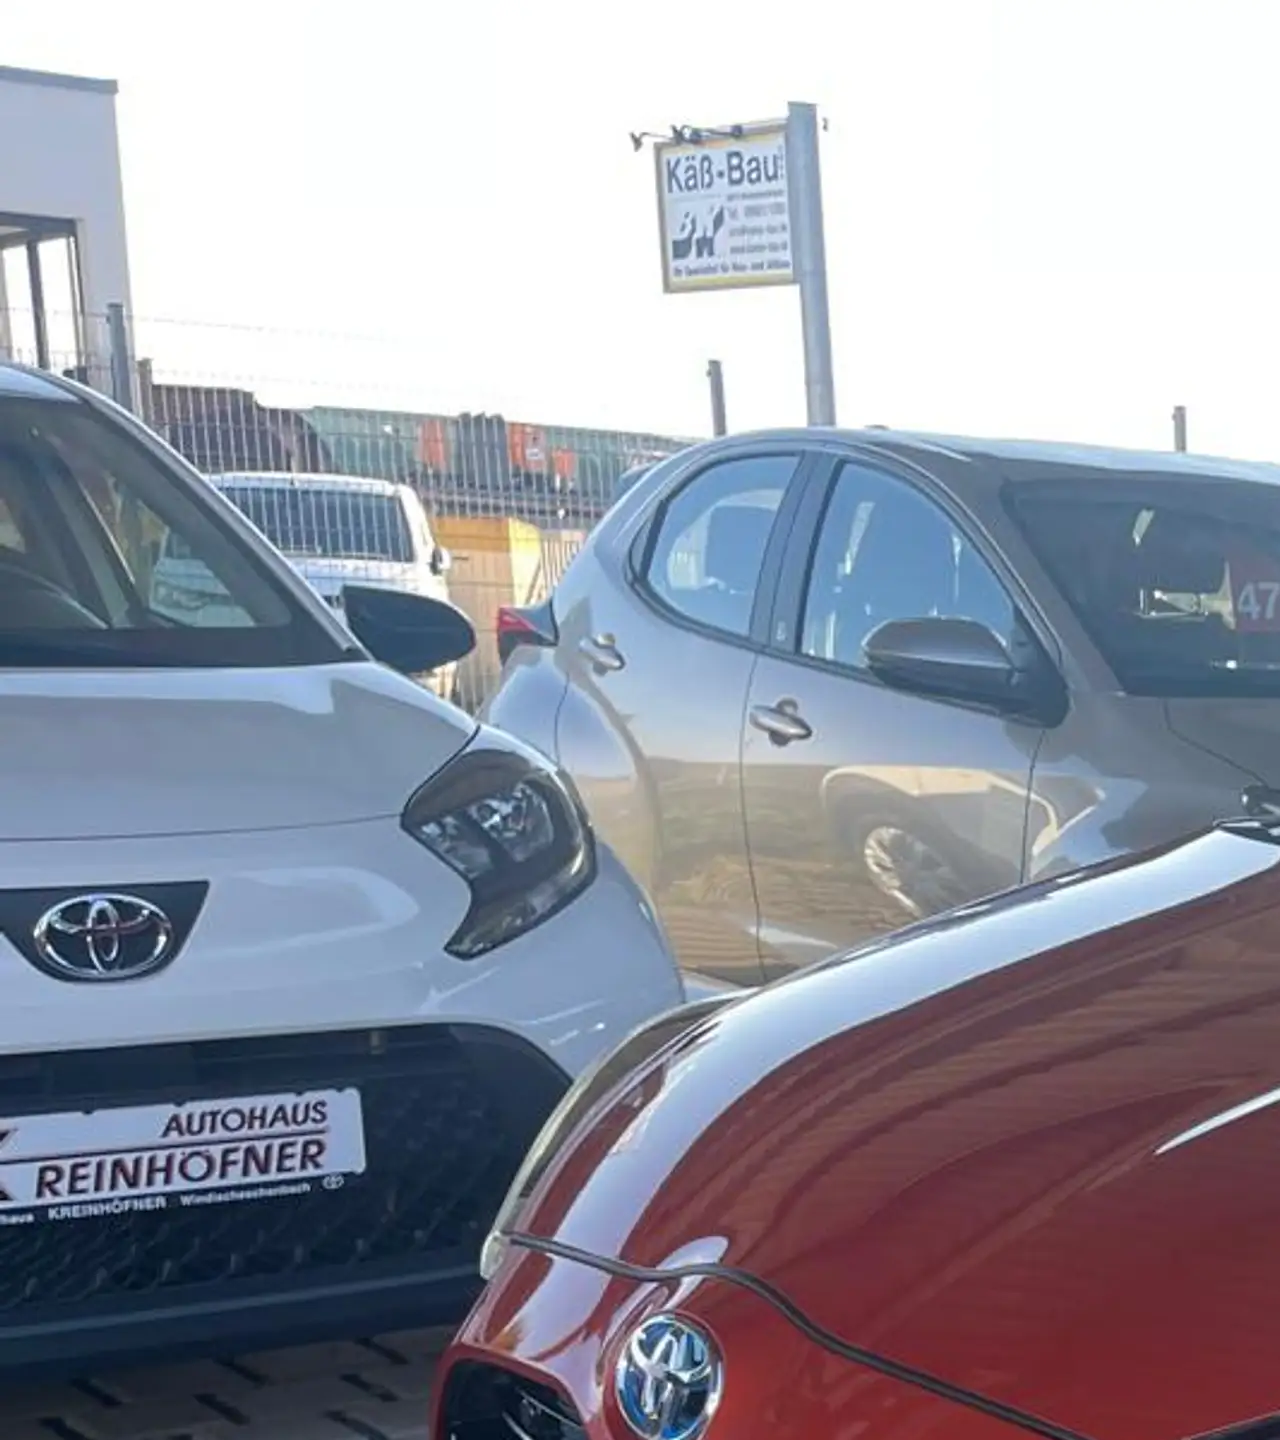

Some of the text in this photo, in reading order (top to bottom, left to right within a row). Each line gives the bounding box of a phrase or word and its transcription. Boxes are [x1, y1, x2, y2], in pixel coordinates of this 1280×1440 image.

[1238, 581, 1280, 620] 47
[161, 1100, 328, 1138] AUTOHAUS
[0, 1128, 327, 1200] REINHÖFNER
